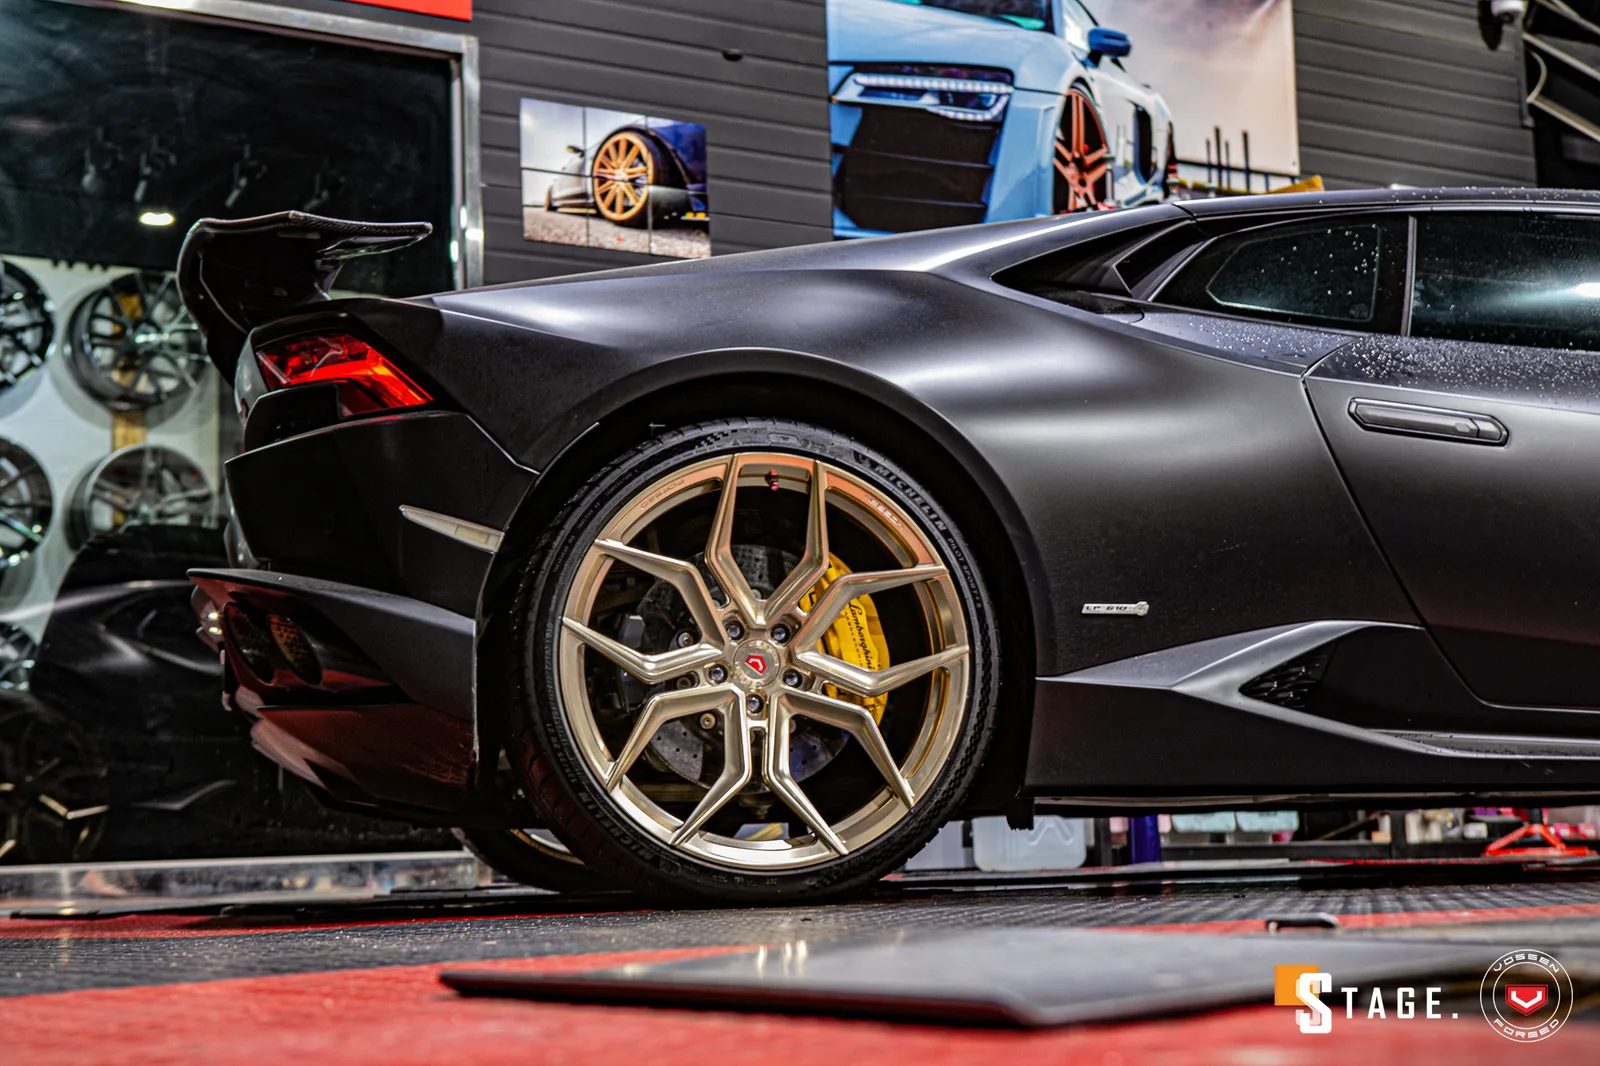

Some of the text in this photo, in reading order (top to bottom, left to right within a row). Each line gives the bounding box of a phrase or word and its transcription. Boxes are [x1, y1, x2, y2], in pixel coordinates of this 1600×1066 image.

[874, 465, 947, 531] MICHELIN
[946, 536, 964, 562] PILOT
[961, 564, 977, 595] SPORT
[849, 601, 876, 670] Lamborghini
[576, 788, 655, 861] MICHELIN
